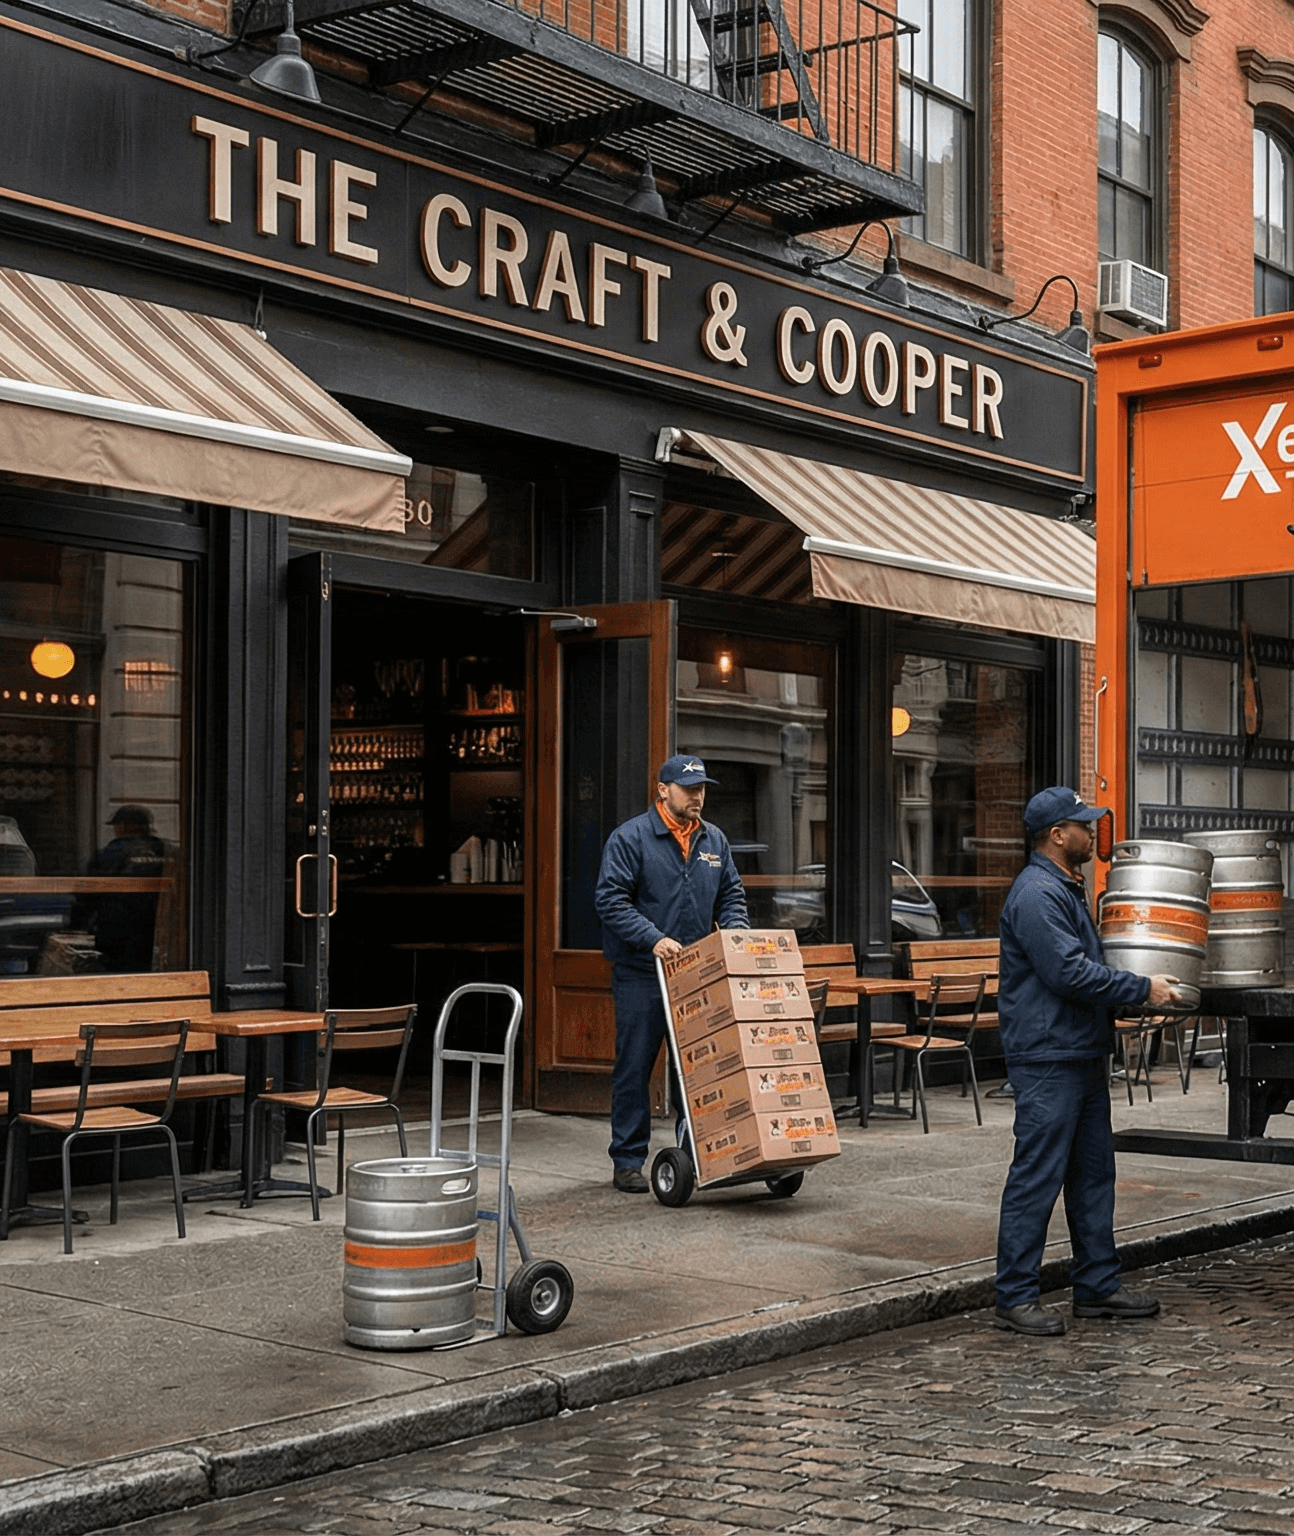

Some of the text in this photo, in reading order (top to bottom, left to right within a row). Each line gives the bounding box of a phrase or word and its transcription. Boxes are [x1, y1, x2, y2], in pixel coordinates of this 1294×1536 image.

[191, 115, 1004, 440] THE CRAFT & COOPER
